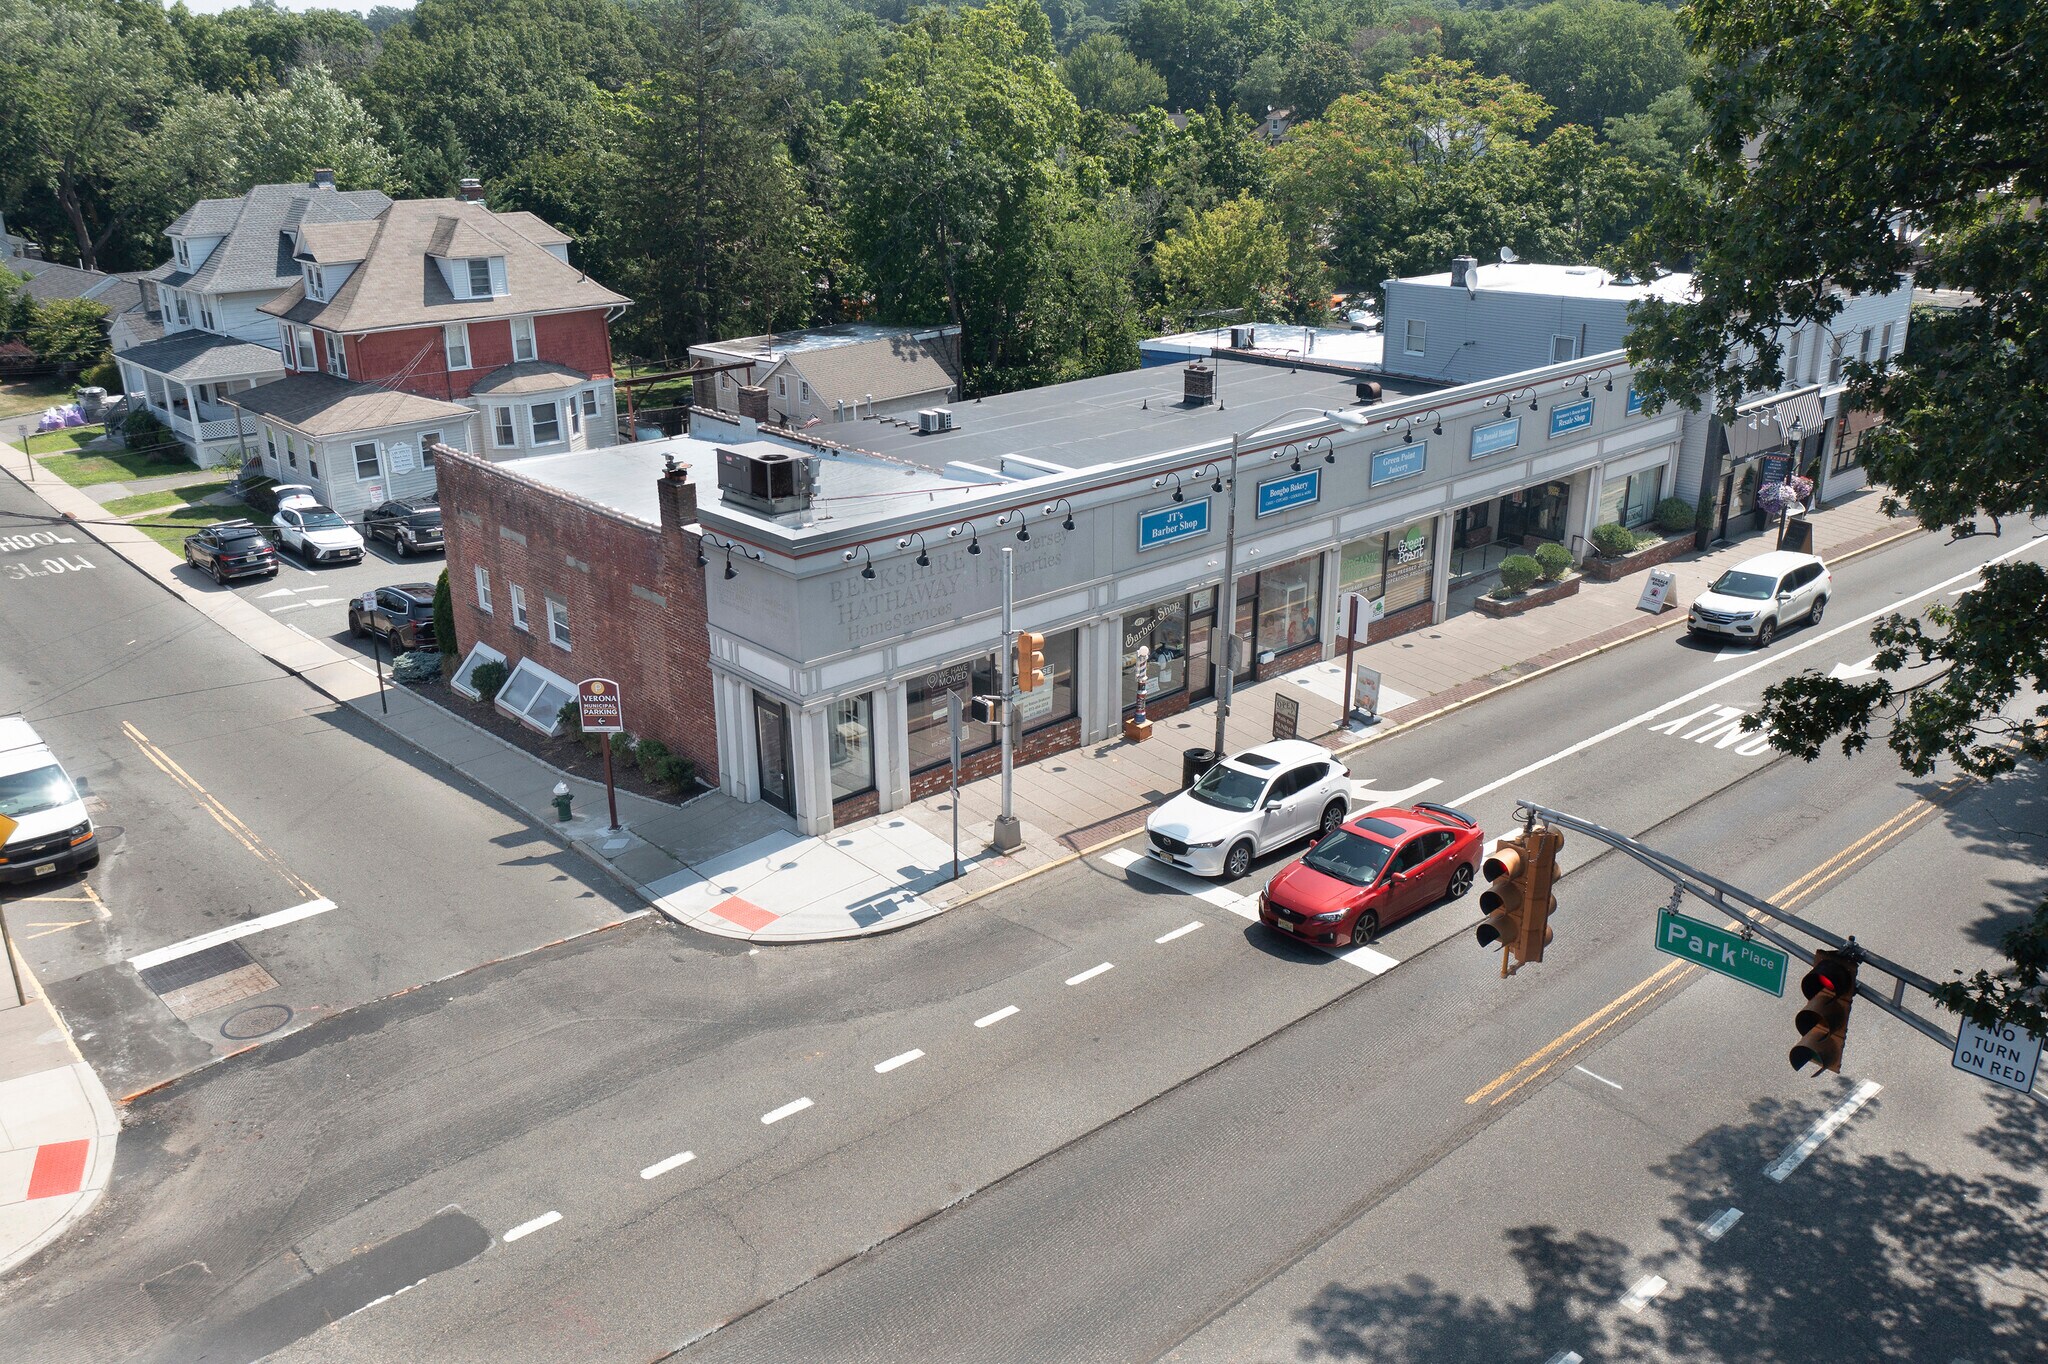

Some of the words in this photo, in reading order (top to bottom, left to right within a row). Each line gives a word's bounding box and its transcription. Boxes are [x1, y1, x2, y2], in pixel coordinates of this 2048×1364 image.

[1573, 414, 1586, 424] Shop
[1382, 456, 1400, 466] Green
[1401, 451, 1416, 461] Point
[1388, 464, 1408, 475] Juicery
[1270, 486, 1290, 498] Bongbo
[1290, 481, 1309, 492] Bakery
[1166, 512, 1184, 524] JT's
[1152, 523, 1178, 538] Barber
[1179, 519, 1198, 532] Shop
[1397, 536, 1425, 553] Green
[1397, 547, 1424, 564] Point
[4, 555, 96, 580] SLOW
[837, 573, 961, 625] HATHAWAY
[847, 602, 953, 641] HomeServices
[1125, 619, 1156, 648] Barber
[1157, 601, 1180, 621] Shop
[938, 669, 951, 679] WE
[951, 662, 969, 675] HAVE
[938, 670, 968, 687] MOVED
[582, 694, 617, 702] VERONA
[1277, 701, 1296, 711] OPEN
[1667, 922, 1737, 967] Park
[1741, 947, 1775, 970] Place
[1988, 1022, 2015, 1042] NO
[1974, 1036, 2021, 1063] TURN
[1961, 1051, 1984, 1069] ON
[1990, 1061, 2026, 1083] RED
